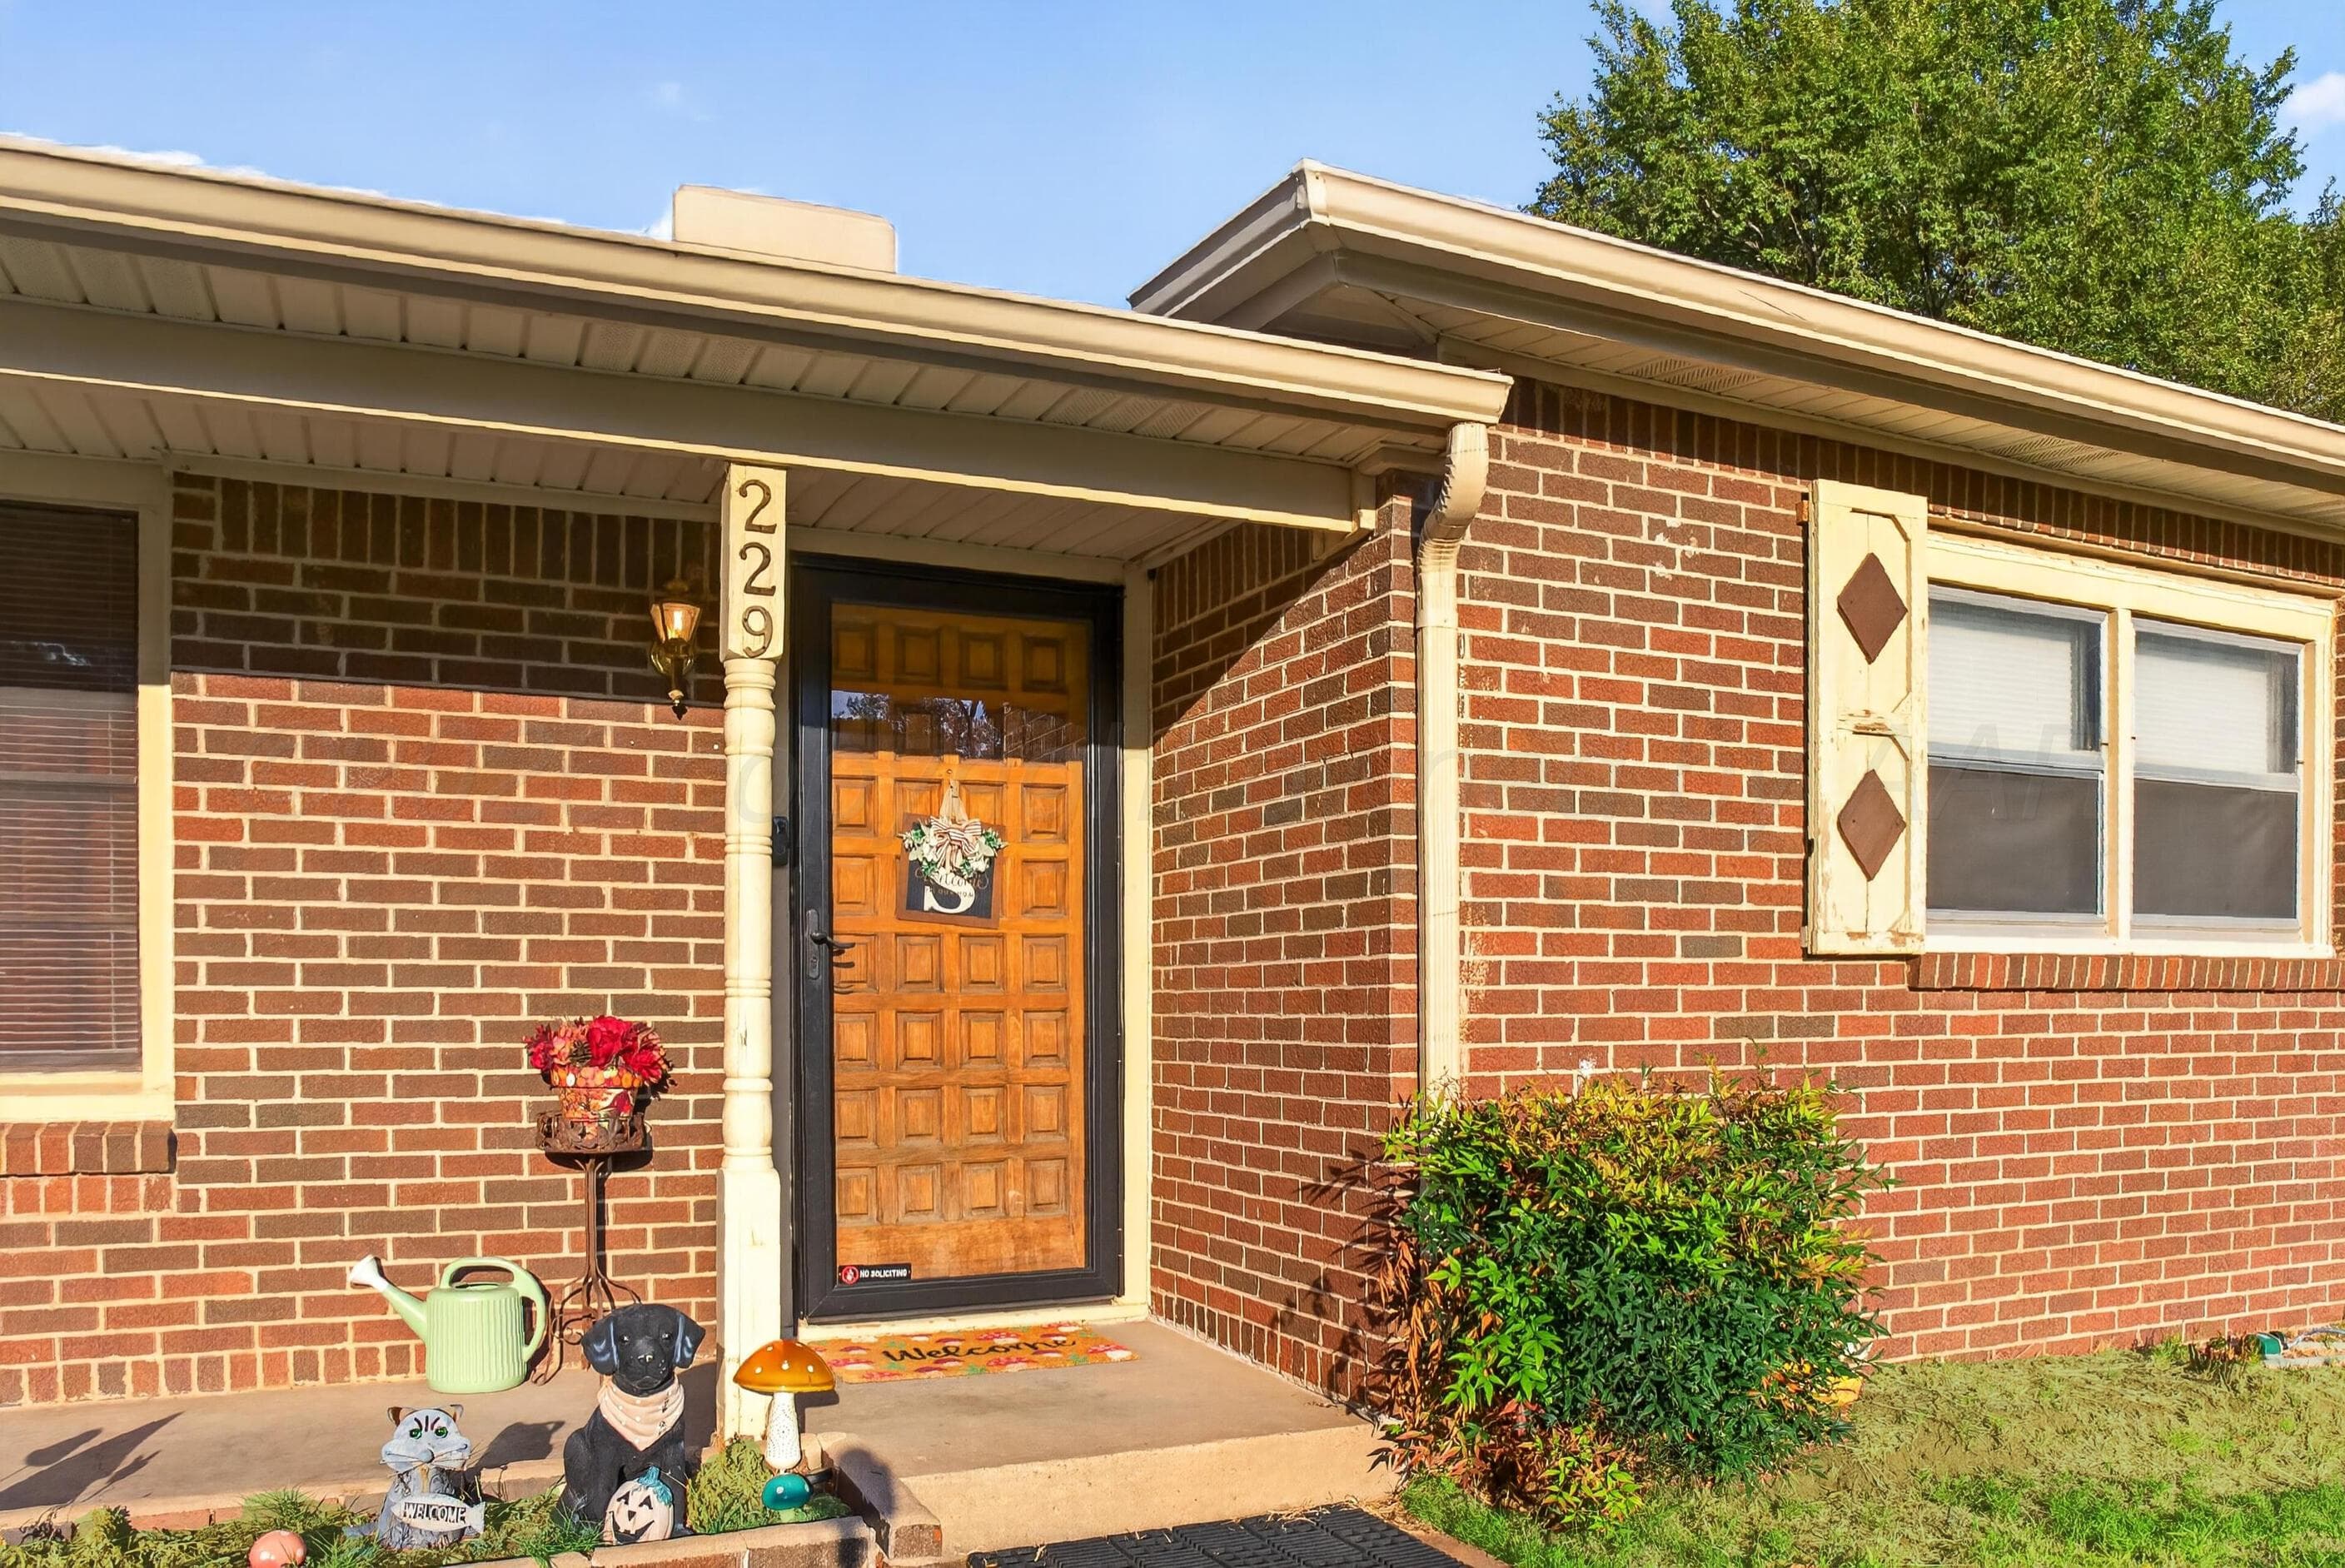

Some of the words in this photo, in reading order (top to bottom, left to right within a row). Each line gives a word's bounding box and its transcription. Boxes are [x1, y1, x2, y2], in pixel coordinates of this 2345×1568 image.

[738, 479, 778, 659] 229
[859, 1269, 870, 1278] NO
[870, 1268, 908, 1277] SOLICITING
[882, 1338, 1076, 1361] Welcome
[403, 1502, 467, 1525] WELCOME
